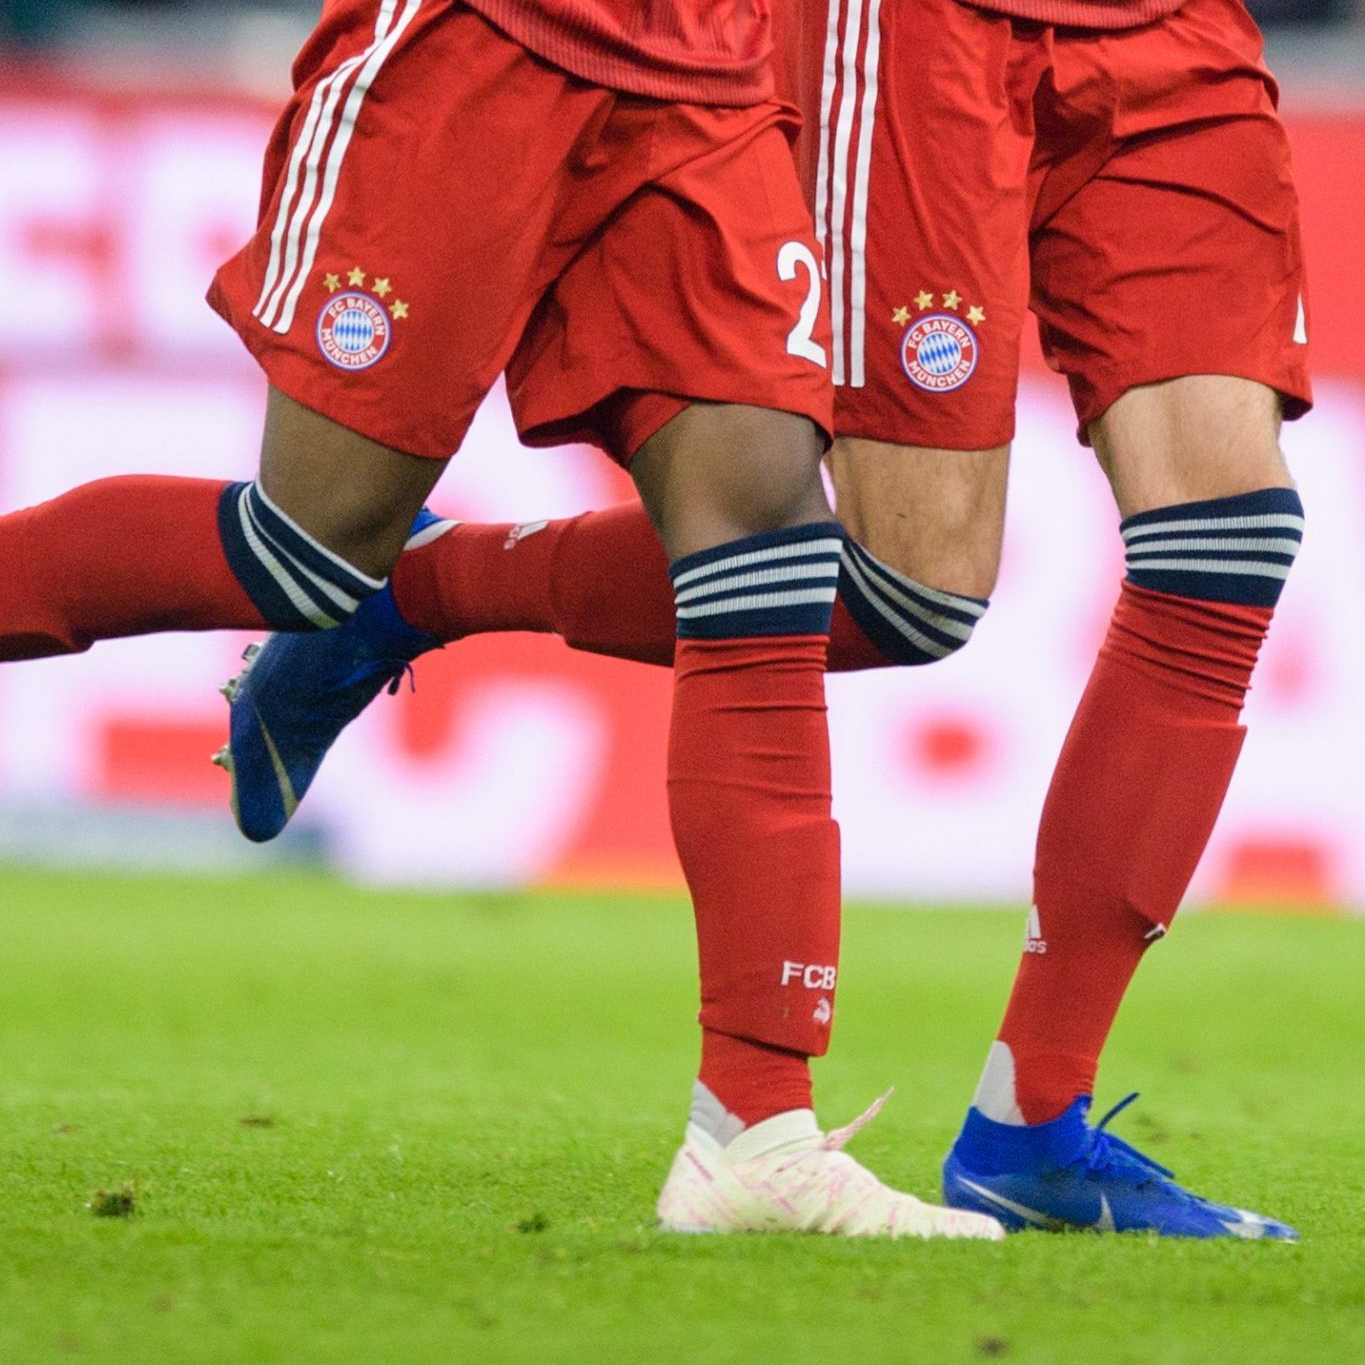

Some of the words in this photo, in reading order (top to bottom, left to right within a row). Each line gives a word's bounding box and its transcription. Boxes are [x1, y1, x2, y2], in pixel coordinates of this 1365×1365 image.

[327, 300, 345, 318] FC
[346, 297, 386, 336] BAYERN
[776, 241, 827, 369] 2
[907, 330, 923, 349] FC
[921, 320, 971, 348] BAYERN
[781, 960, 837, 990] FCB
